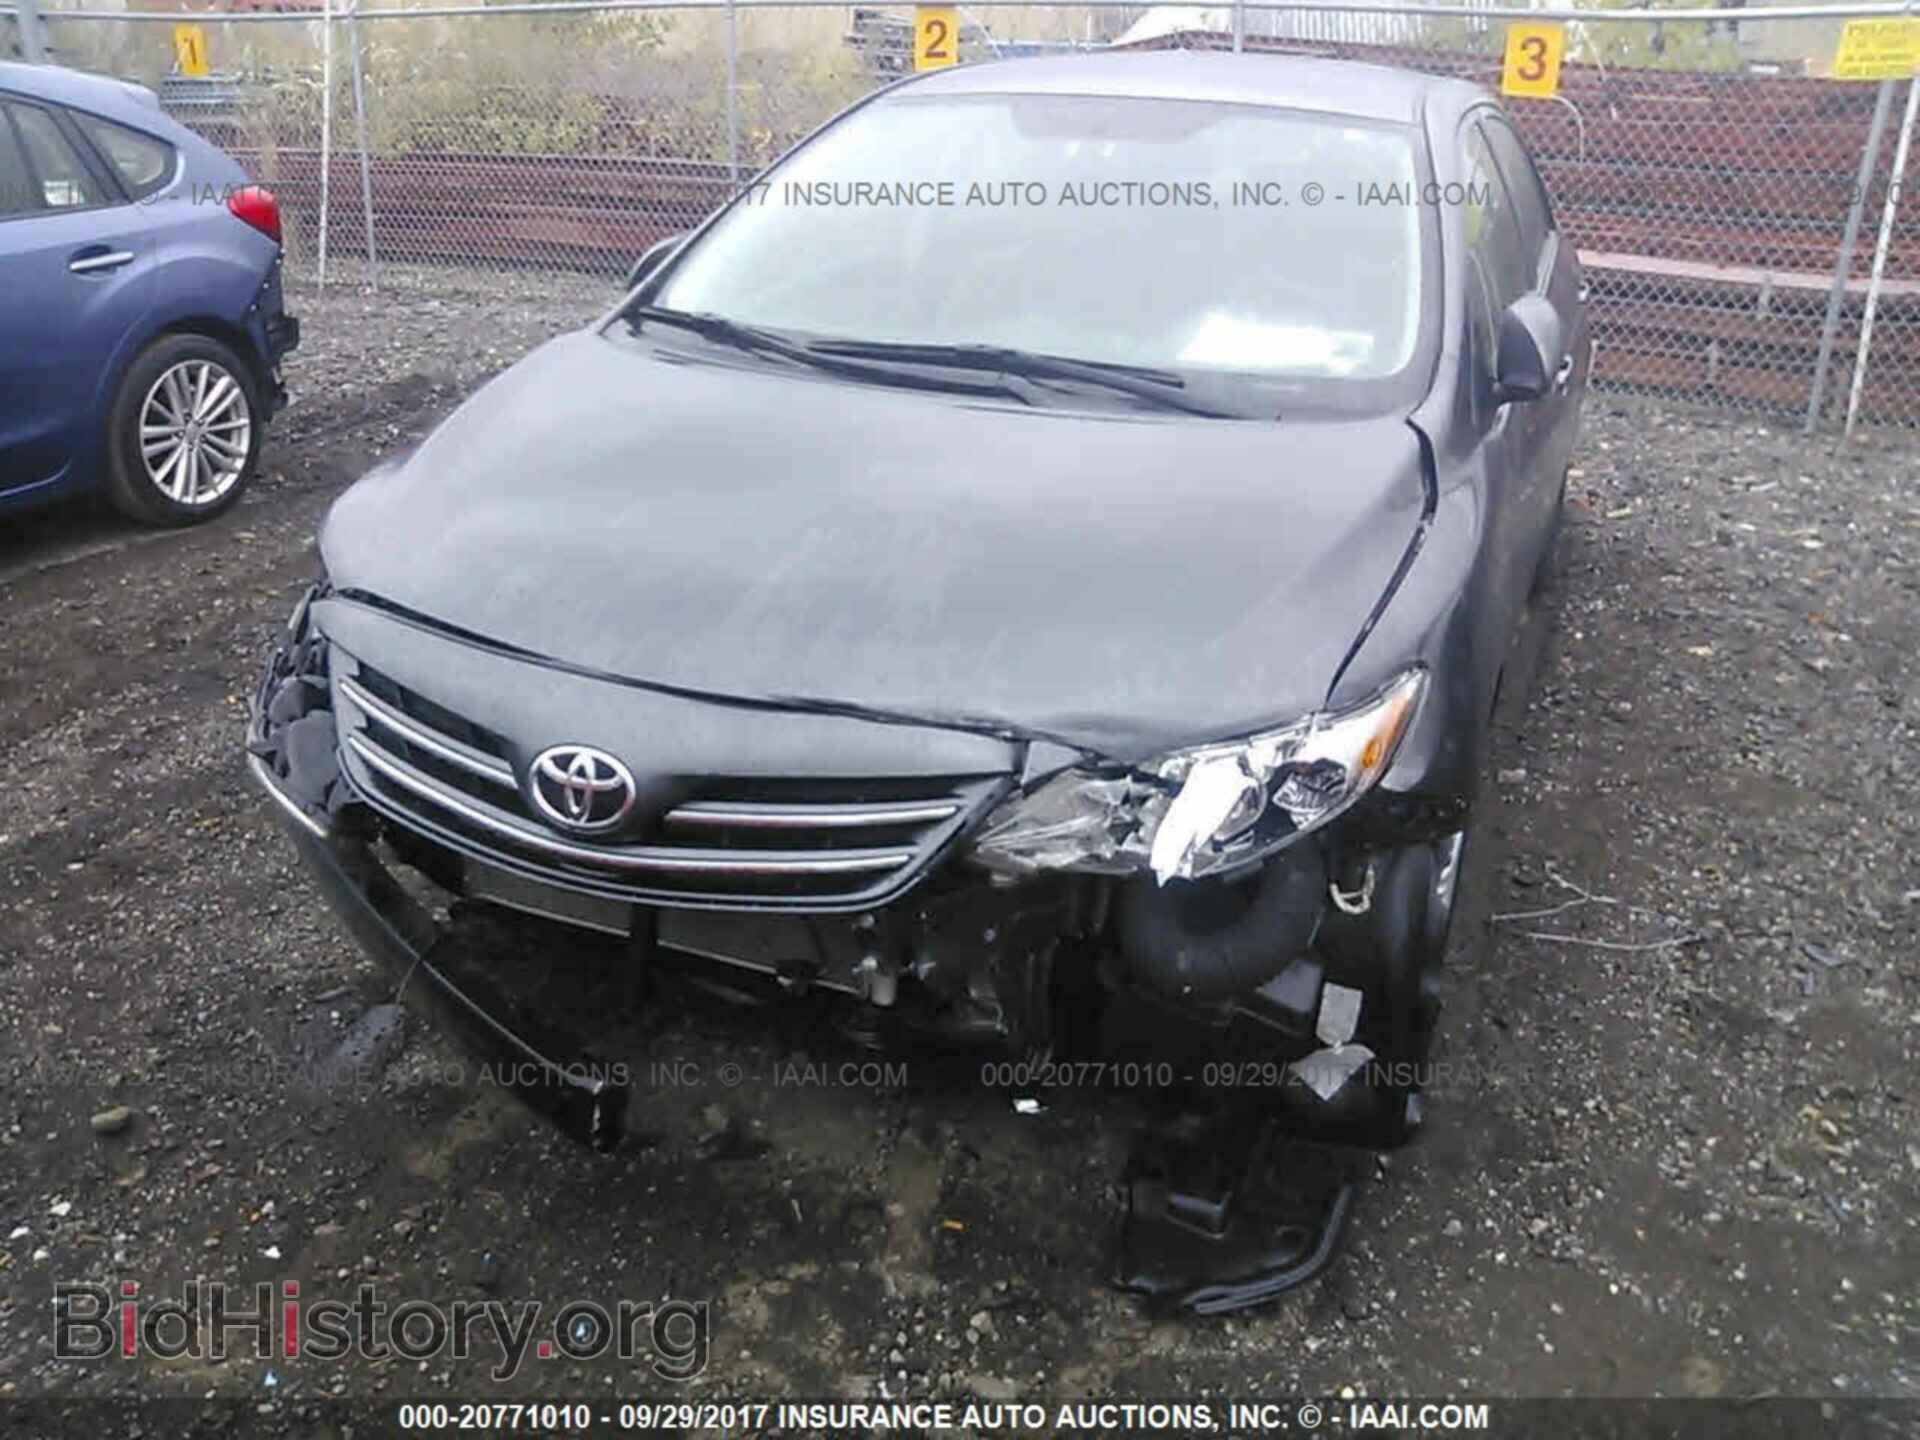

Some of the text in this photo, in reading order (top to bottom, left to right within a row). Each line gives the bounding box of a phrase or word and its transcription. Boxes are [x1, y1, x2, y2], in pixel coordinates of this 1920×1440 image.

[183, 36, 198, 68] 1
[924, 19, 948, 59] 2
[1517, 36, 1548, 81] 3
